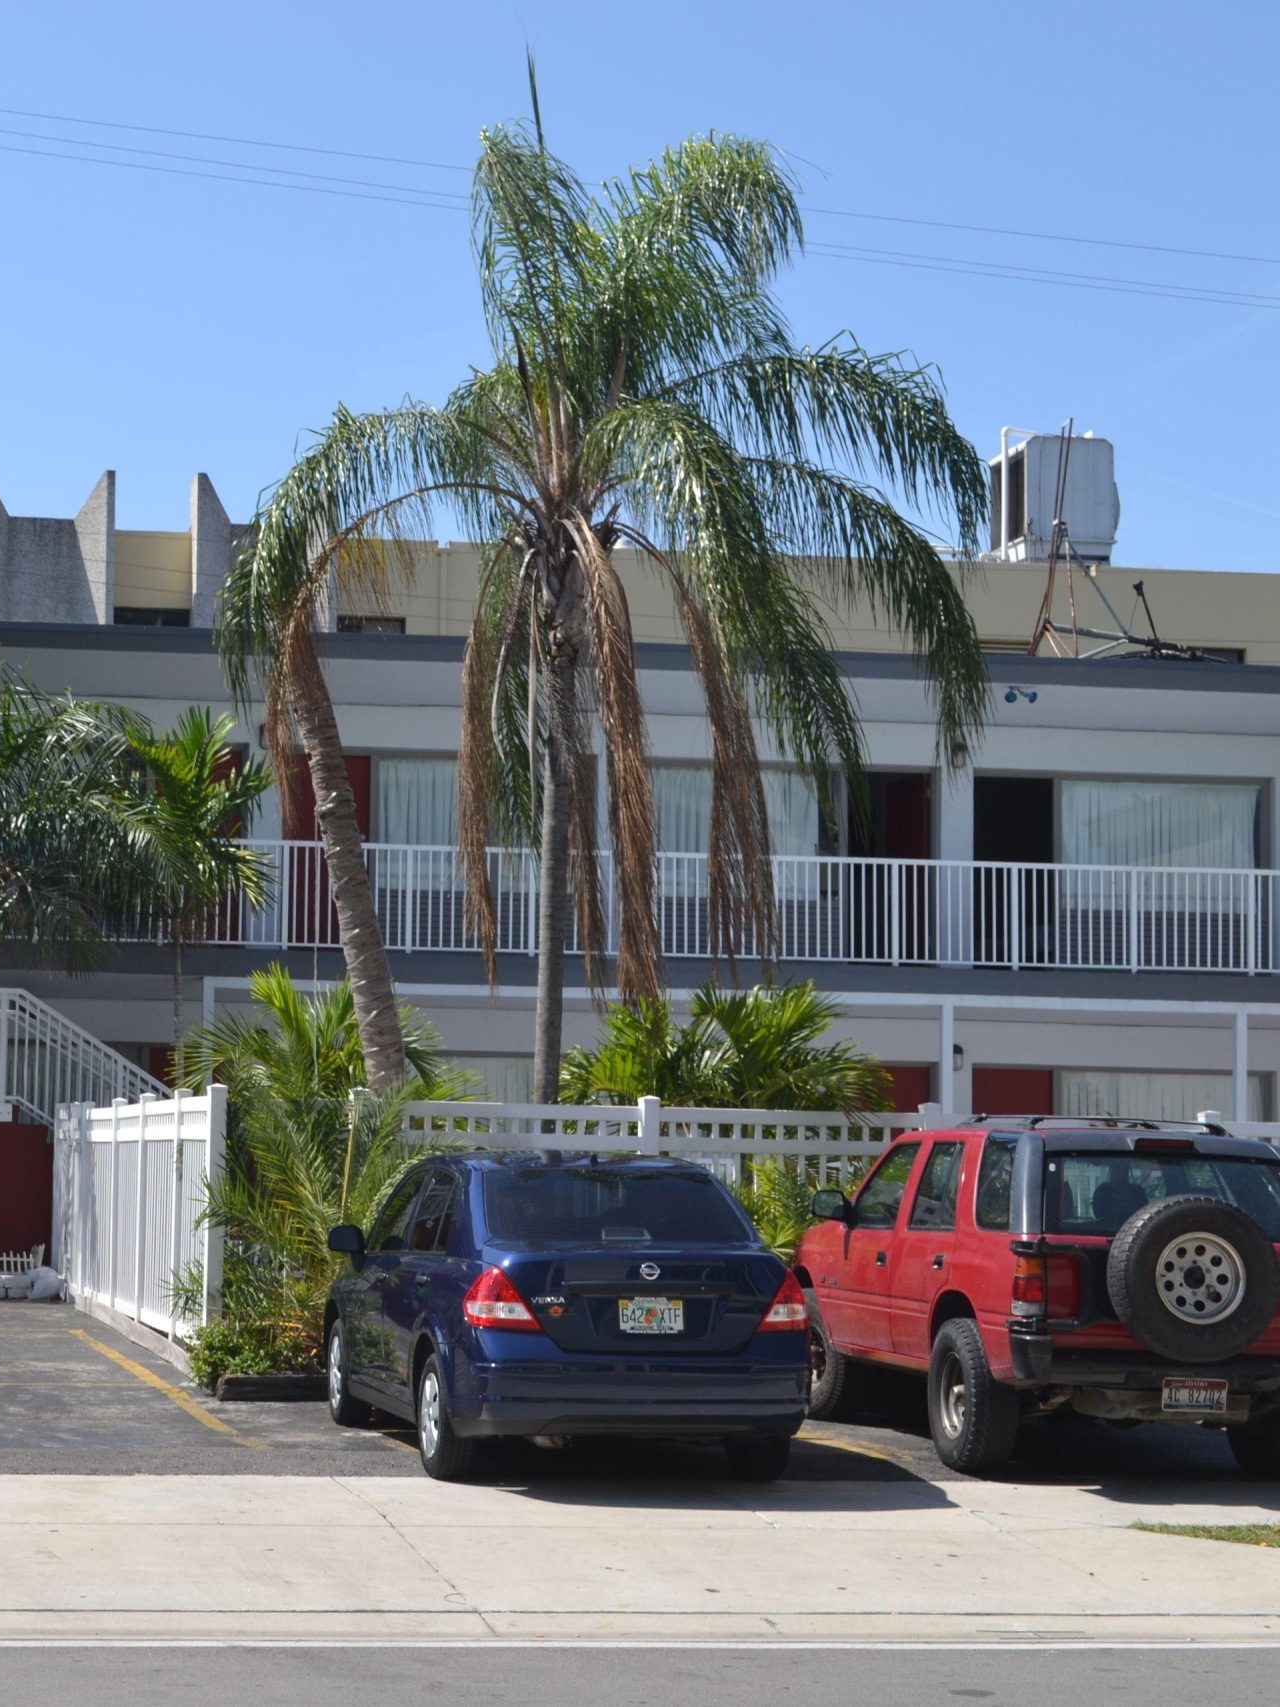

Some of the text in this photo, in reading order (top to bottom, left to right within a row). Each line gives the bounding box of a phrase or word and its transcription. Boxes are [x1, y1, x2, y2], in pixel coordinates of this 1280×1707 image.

[530, 1296, 565, 1304] VERSA
[621, 1307, 681, 1324] 642 XTF
